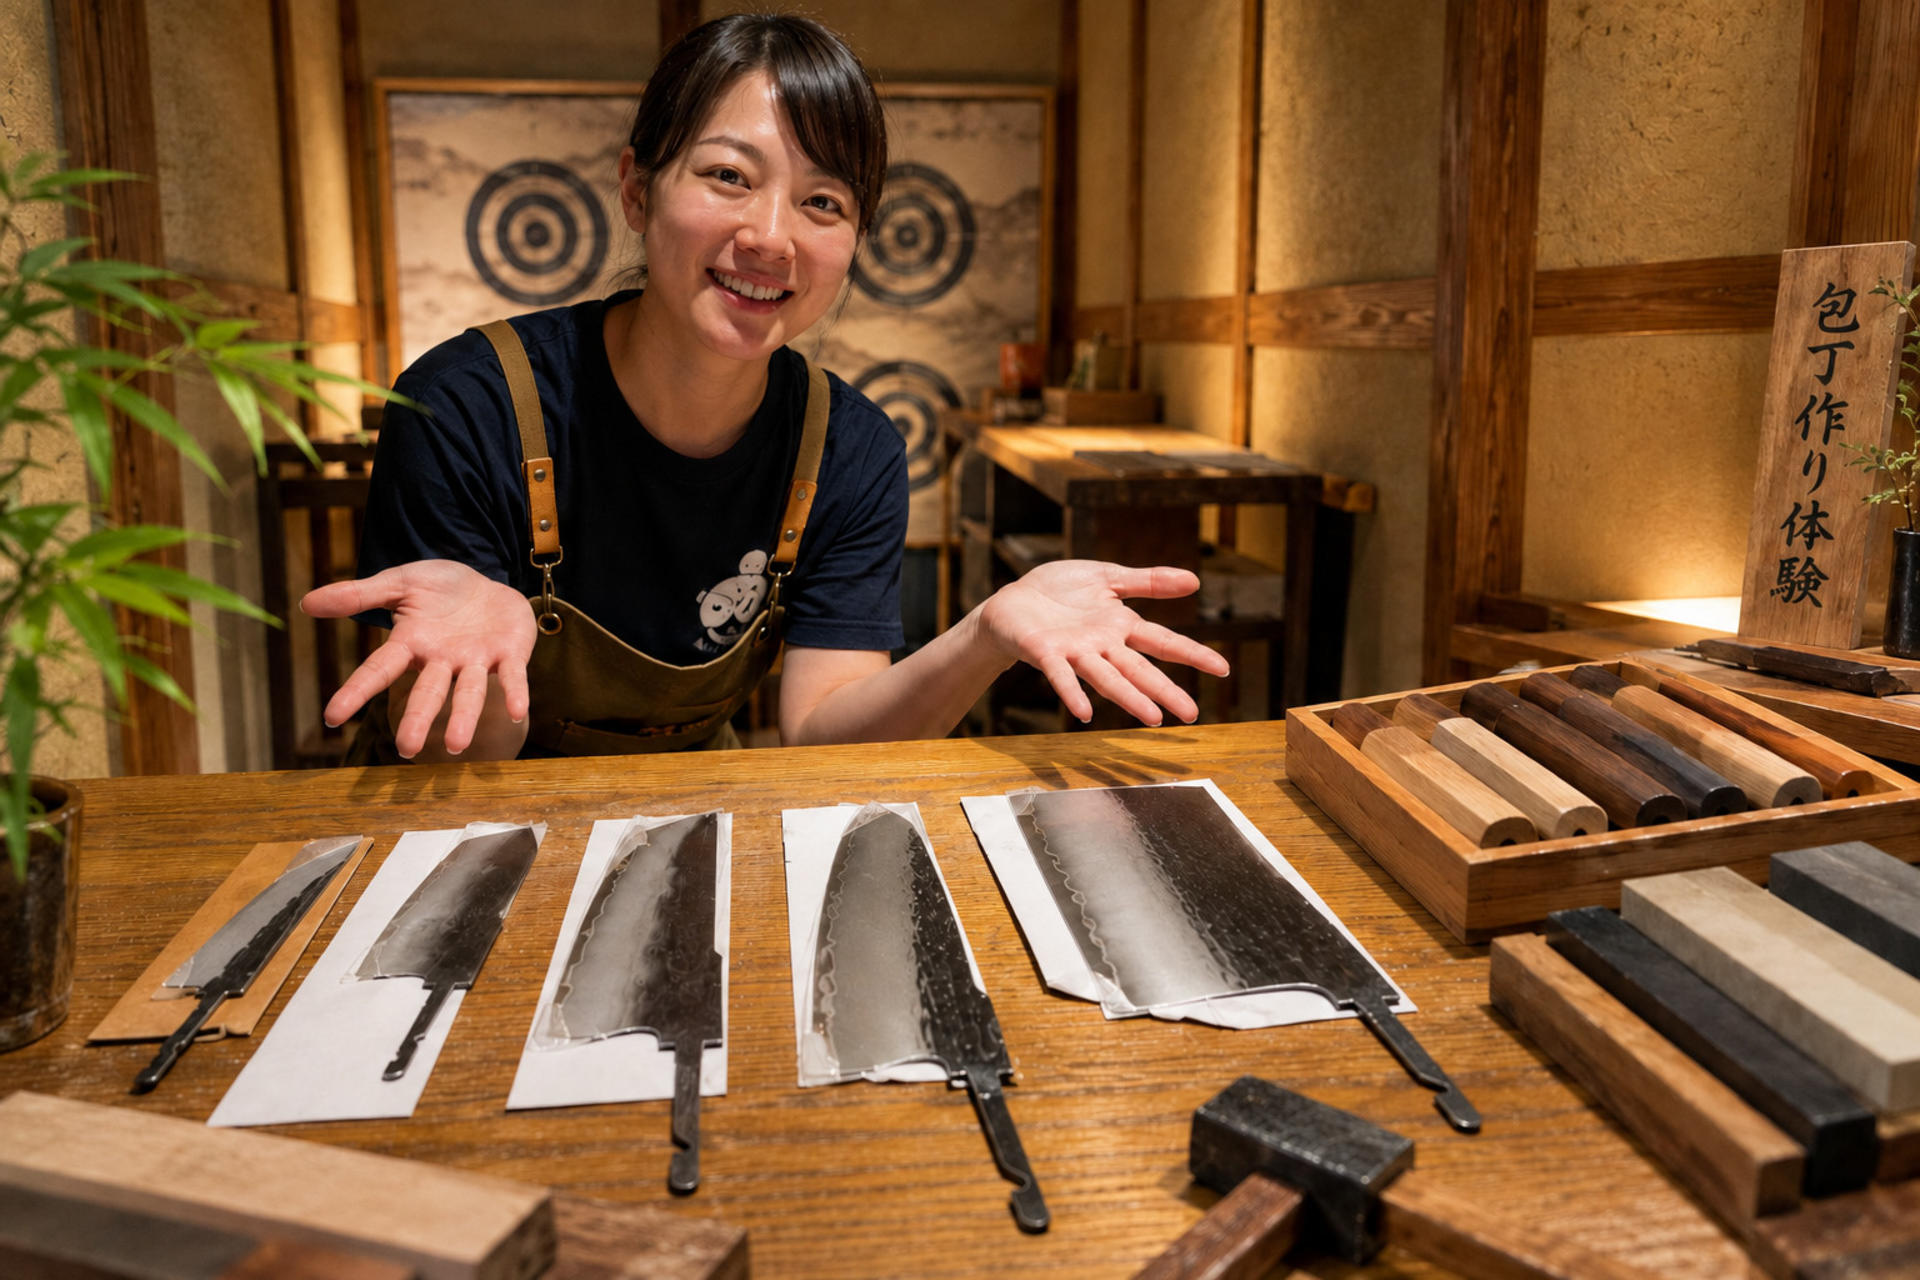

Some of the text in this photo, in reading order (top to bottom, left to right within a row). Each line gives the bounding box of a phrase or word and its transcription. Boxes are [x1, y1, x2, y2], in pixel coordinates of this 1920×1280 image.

[1769, 282, 1860, 608] 包丁作り体験
